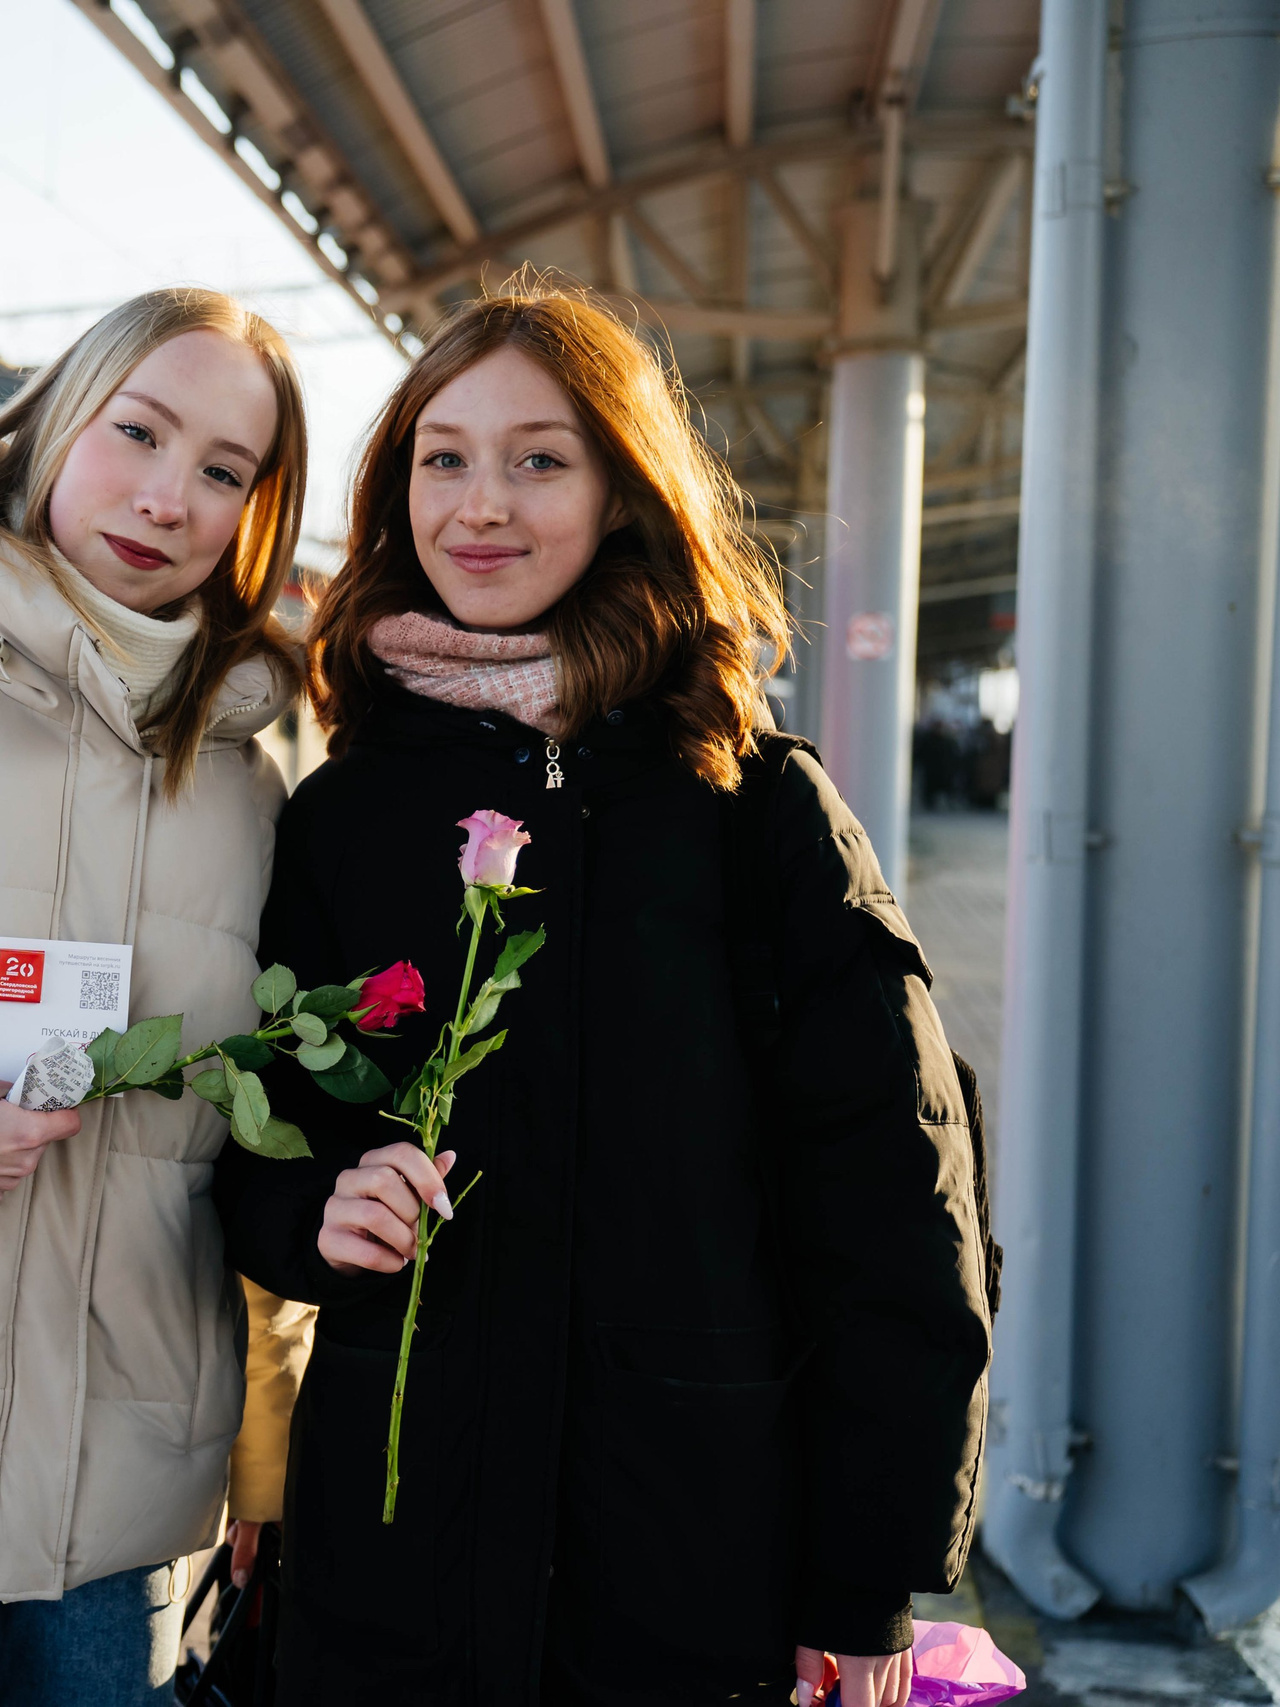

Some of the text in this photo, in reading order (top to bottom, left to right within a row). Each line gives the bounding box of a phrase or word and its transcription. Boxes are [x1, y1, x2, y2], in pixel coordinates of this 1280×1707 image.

[6, 957, 34, 977] 20
[0, 980, 37, 989] Свердловской
[0, 987, 35, 995] пригородной
[42, 1027, 79, 1038] ПУСКАЙ
